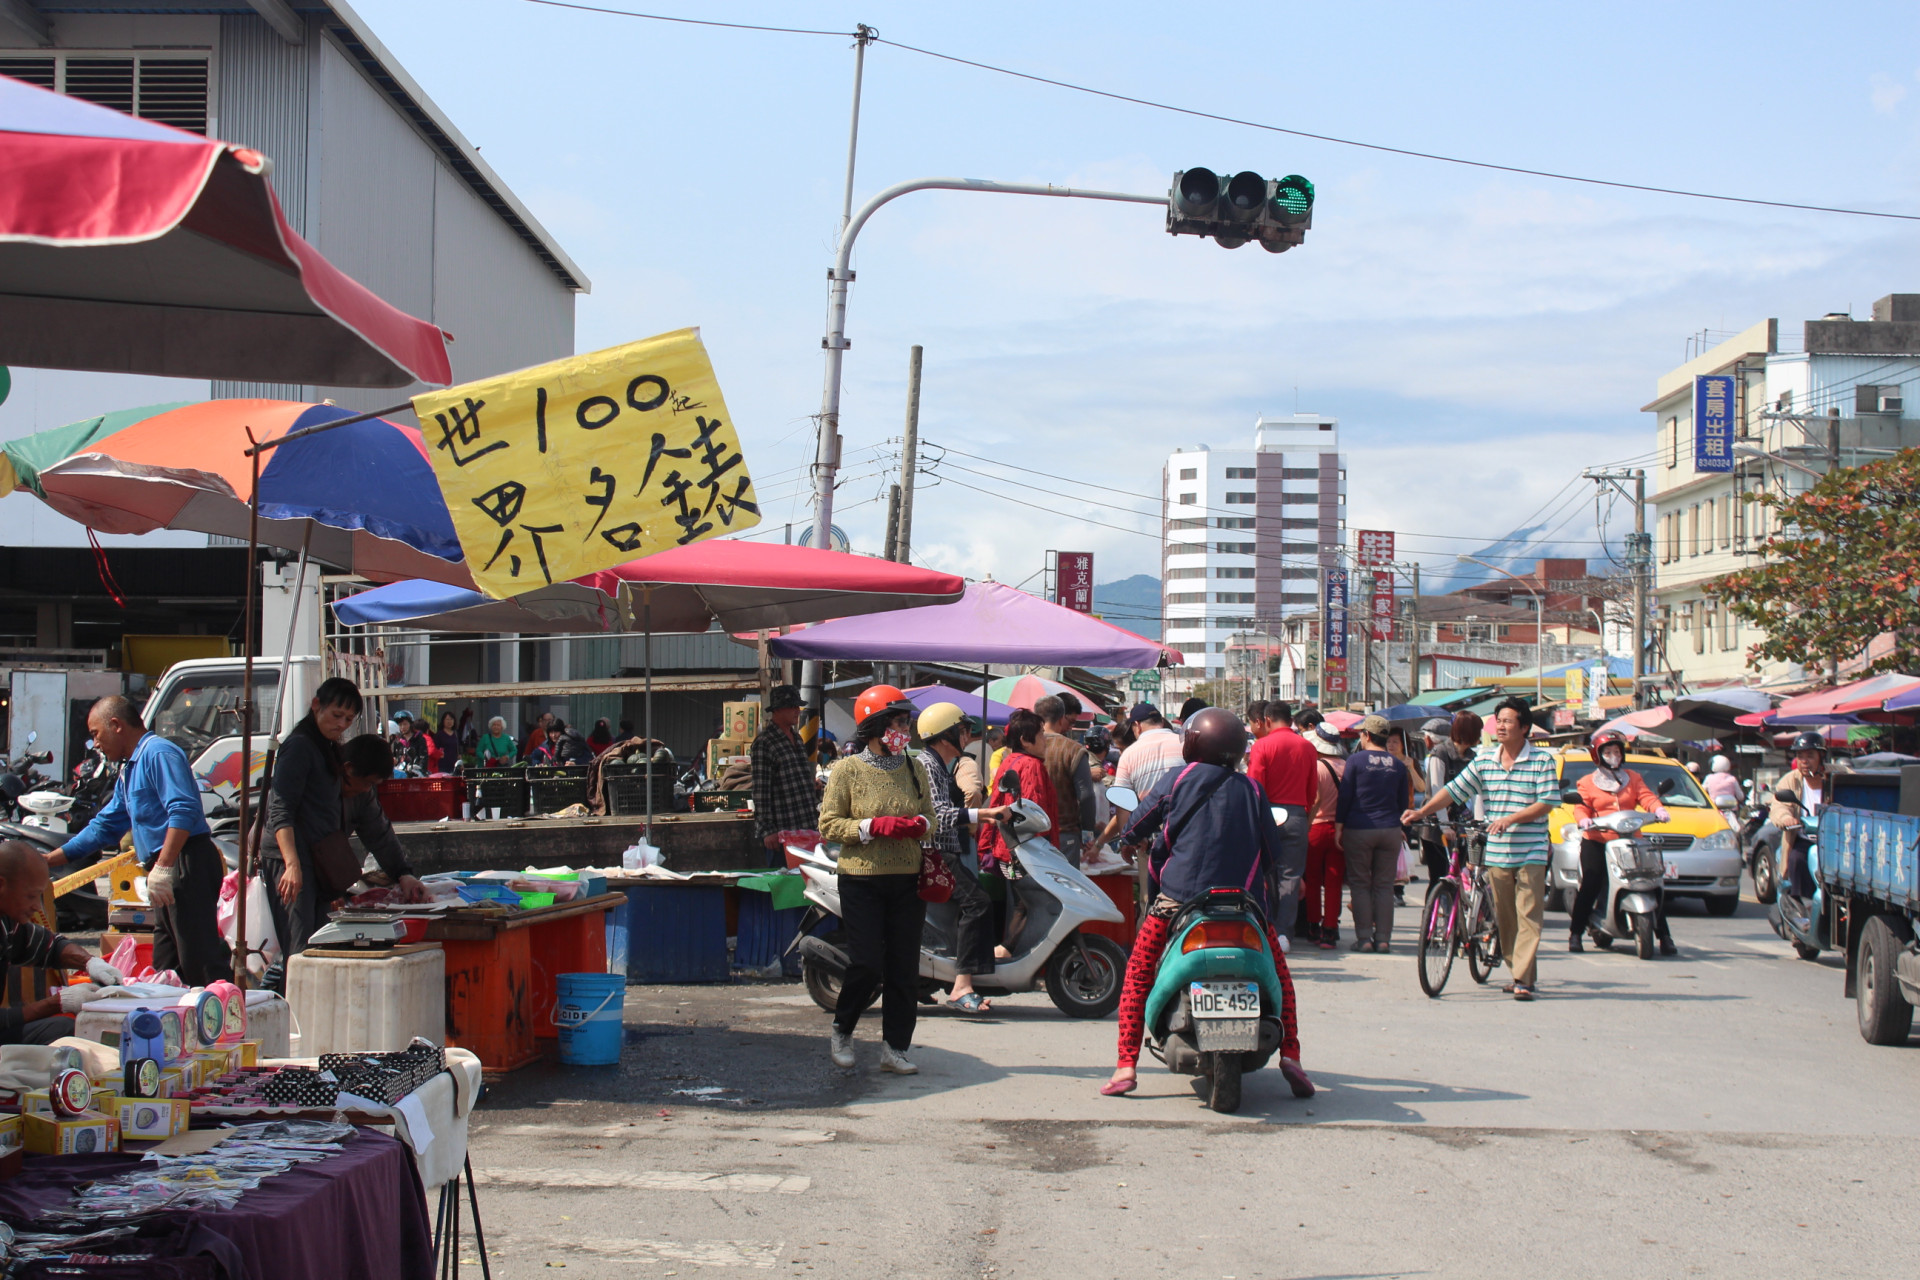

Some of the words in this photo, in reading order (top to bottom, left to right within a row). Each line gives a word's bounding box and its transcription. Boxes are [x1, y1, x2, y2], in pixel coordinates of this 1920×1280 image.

[1705, 379, 1727, 457] 套房出租
[1361, 533, 1392, 567] 鞋
[1375, 578, 1392, 633] 全家福
[1331, 676, 1343, 688] P
